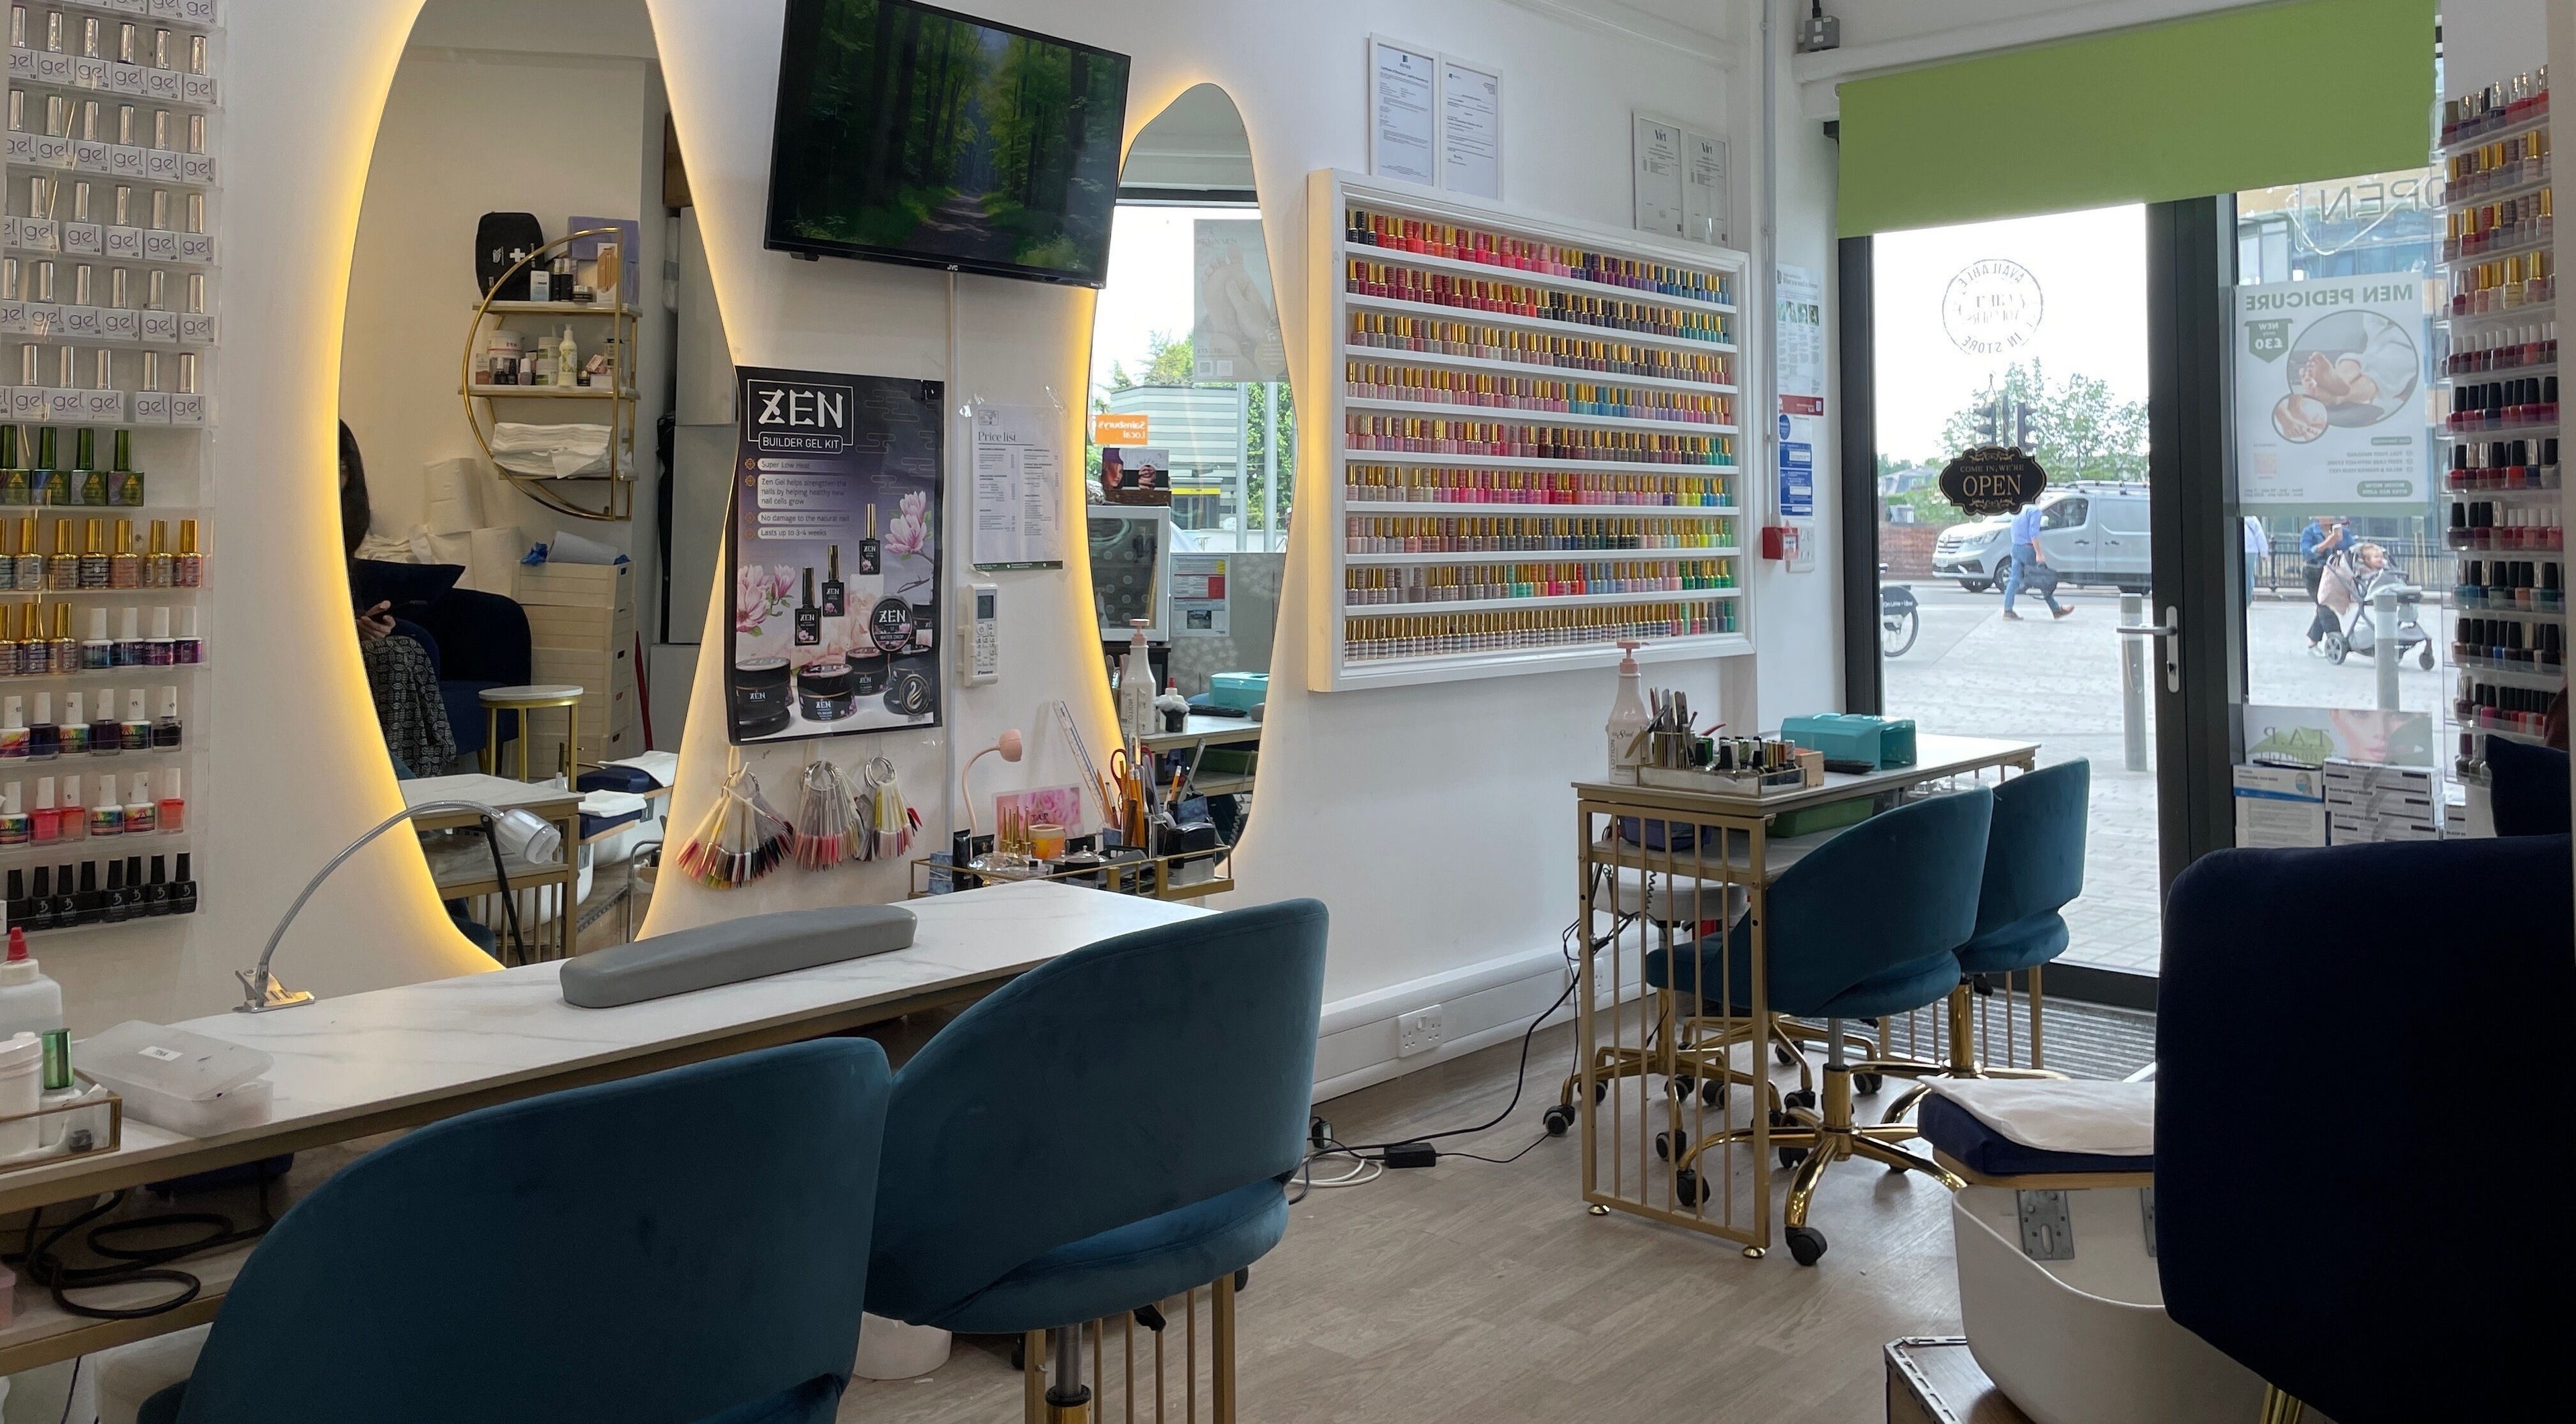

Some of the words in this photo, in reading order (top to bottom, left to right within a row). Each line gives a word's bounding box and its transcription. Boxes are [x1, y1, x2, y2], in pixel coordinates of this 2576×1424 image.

[41, 58, 70, 74] gel
[78, 62, 108, 79] gel
[115, 68, 144, 85] gel
[150, 73, 179, 90] gel
[186, 79, 215, 96] gel
[40, 140, 70, 158] gel
[78, 145, 108, 162] gel
[114, 150, 144, 168] gel
[150, 154, 178, 172] gel
[185, 158, 213, 176] gel
[25, 222, 55, 240] gel
[68, 226, 99, 245] gel
[109, 231, 140, 249] gel
[148, 233, 177, 252] gel
[182, 237, 211, 255] gel
[32, 307, 64, 326] gel
[69, 311, 100, 329] gel
[105, 312, 136, 331] gel
[146, 315, 175, 333] gel
[184, 317, 212, 335] gel
[15, 390, 46, 410] gel
[53, 391, 84, 411] gel
[90, 392, 121, 412] gel
[138, 396, 167, 415] gel
[174, 396, 203, 416] gel
[758, 389, 843, 428] ZEN
[763, 437, 803, 447] BUILDER
[805, 438, 822, 449] GEL
[825, 439, 839, 449] KIT
[978, 431, 1002, 442] Price
[1004, 432, 1017, 442] list
[787, 479, 803, 487] helps
[804, 480, 836, 488] strengthen
[1963, 475, 2022, 497] OPEN
[786, 489, 808, 497] helping
[772, 514, 796, 523] damage
[879, 610, 906, 623] ZEN
